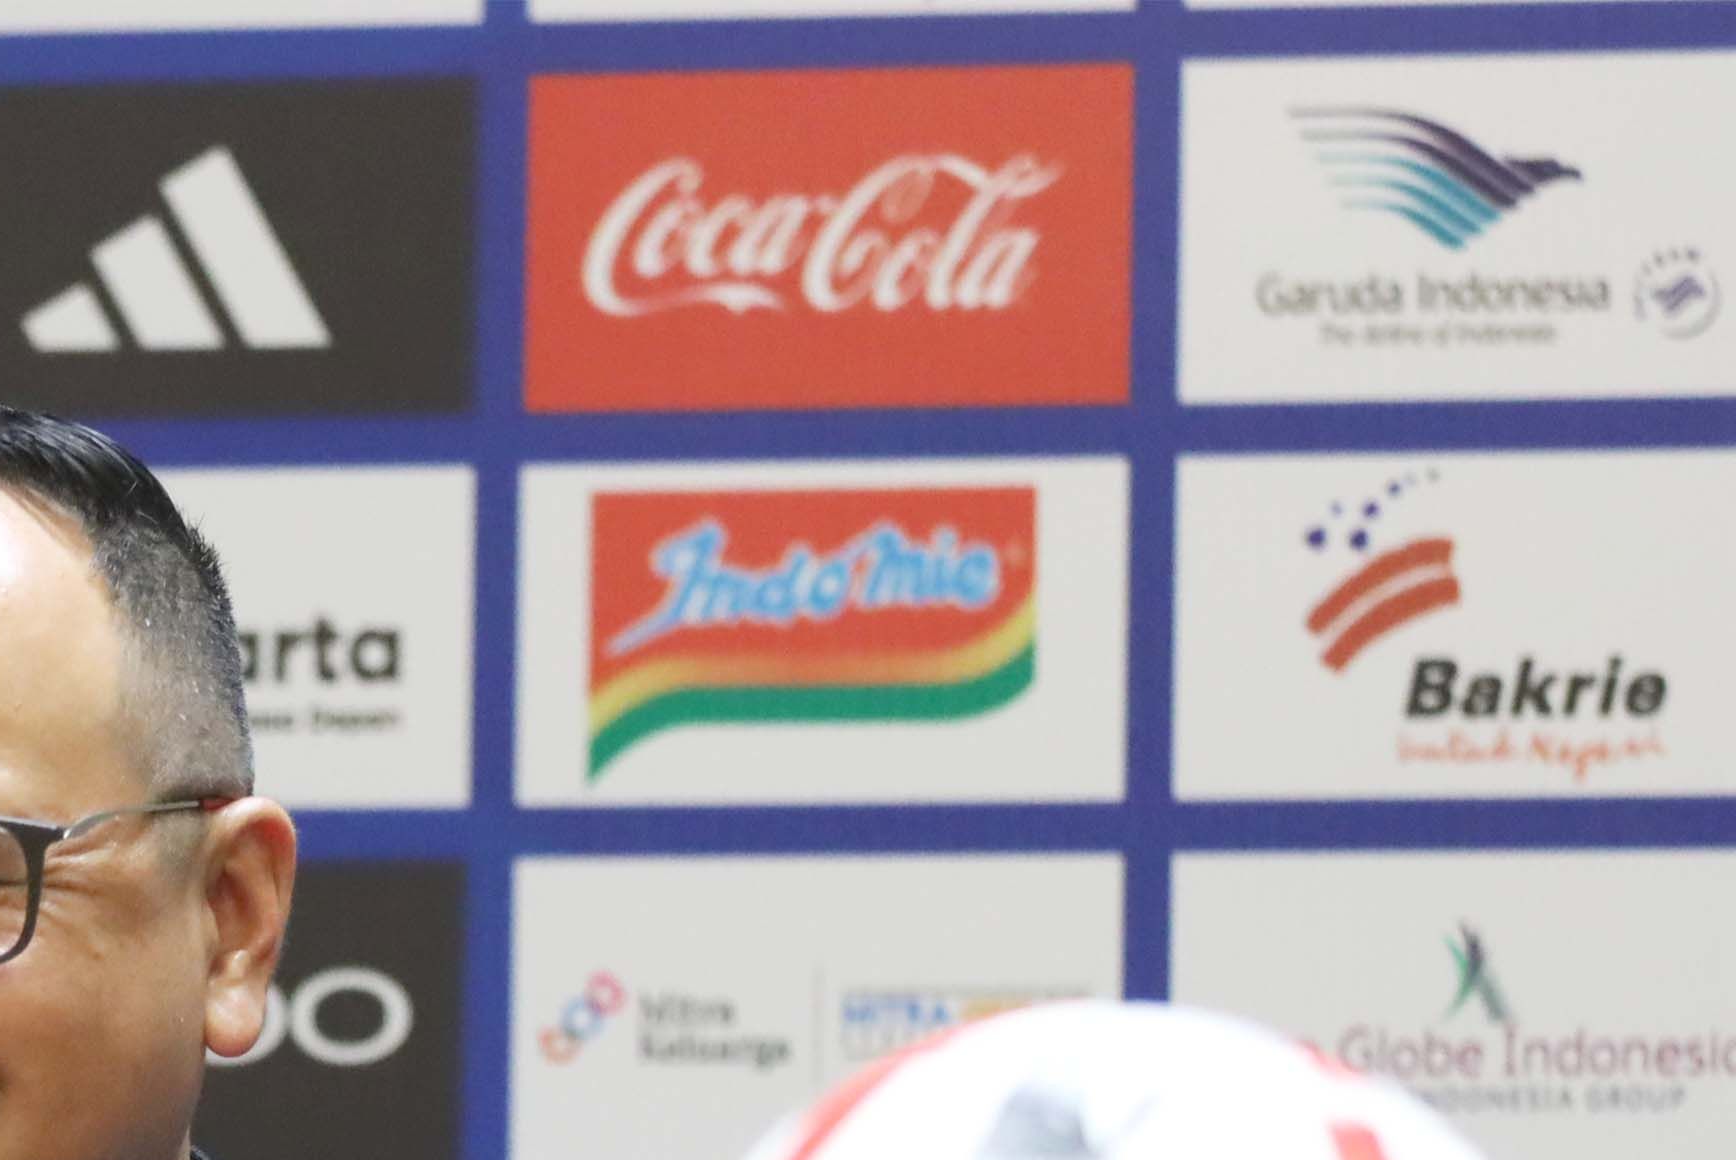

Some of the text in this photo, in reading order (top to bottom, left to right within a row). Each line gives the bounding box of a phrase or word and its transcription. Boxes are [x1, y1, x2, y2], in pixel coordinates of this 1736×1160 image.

[1256, 274, 1403, 318] Garuda
[1416, 274, 1612, 312] Indonesia
[1404, 652, 1668, 720] Bakrie
[1337, 1025, 1486, 1077] Globe
